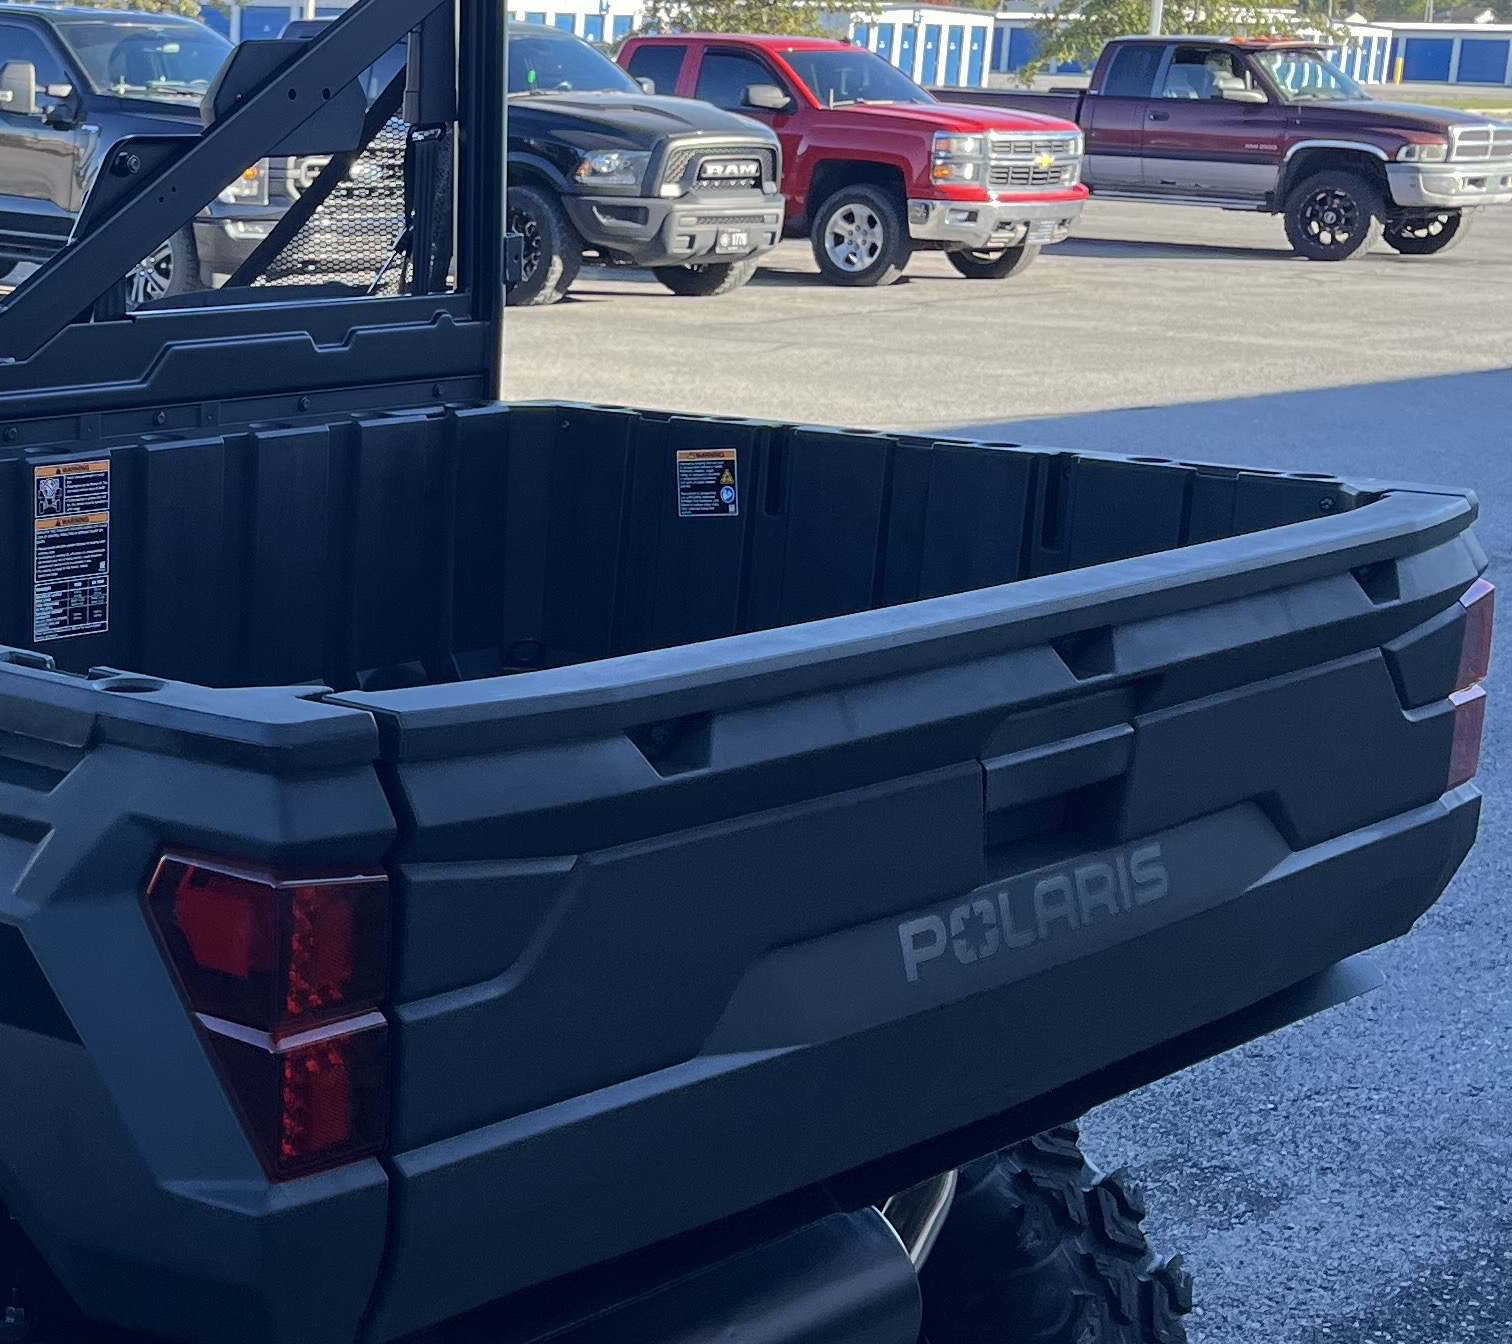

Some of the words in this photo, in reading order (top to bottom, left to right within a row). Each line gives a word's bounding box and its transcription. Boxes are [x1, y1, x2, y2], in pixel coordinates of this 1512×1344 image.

[705, 164, 758, 175] RAM
[61, 464, 90, 473] WARNING
[61, 515, 90, 525] WARNING
[897, 842, 1170, 983] POLARIS
